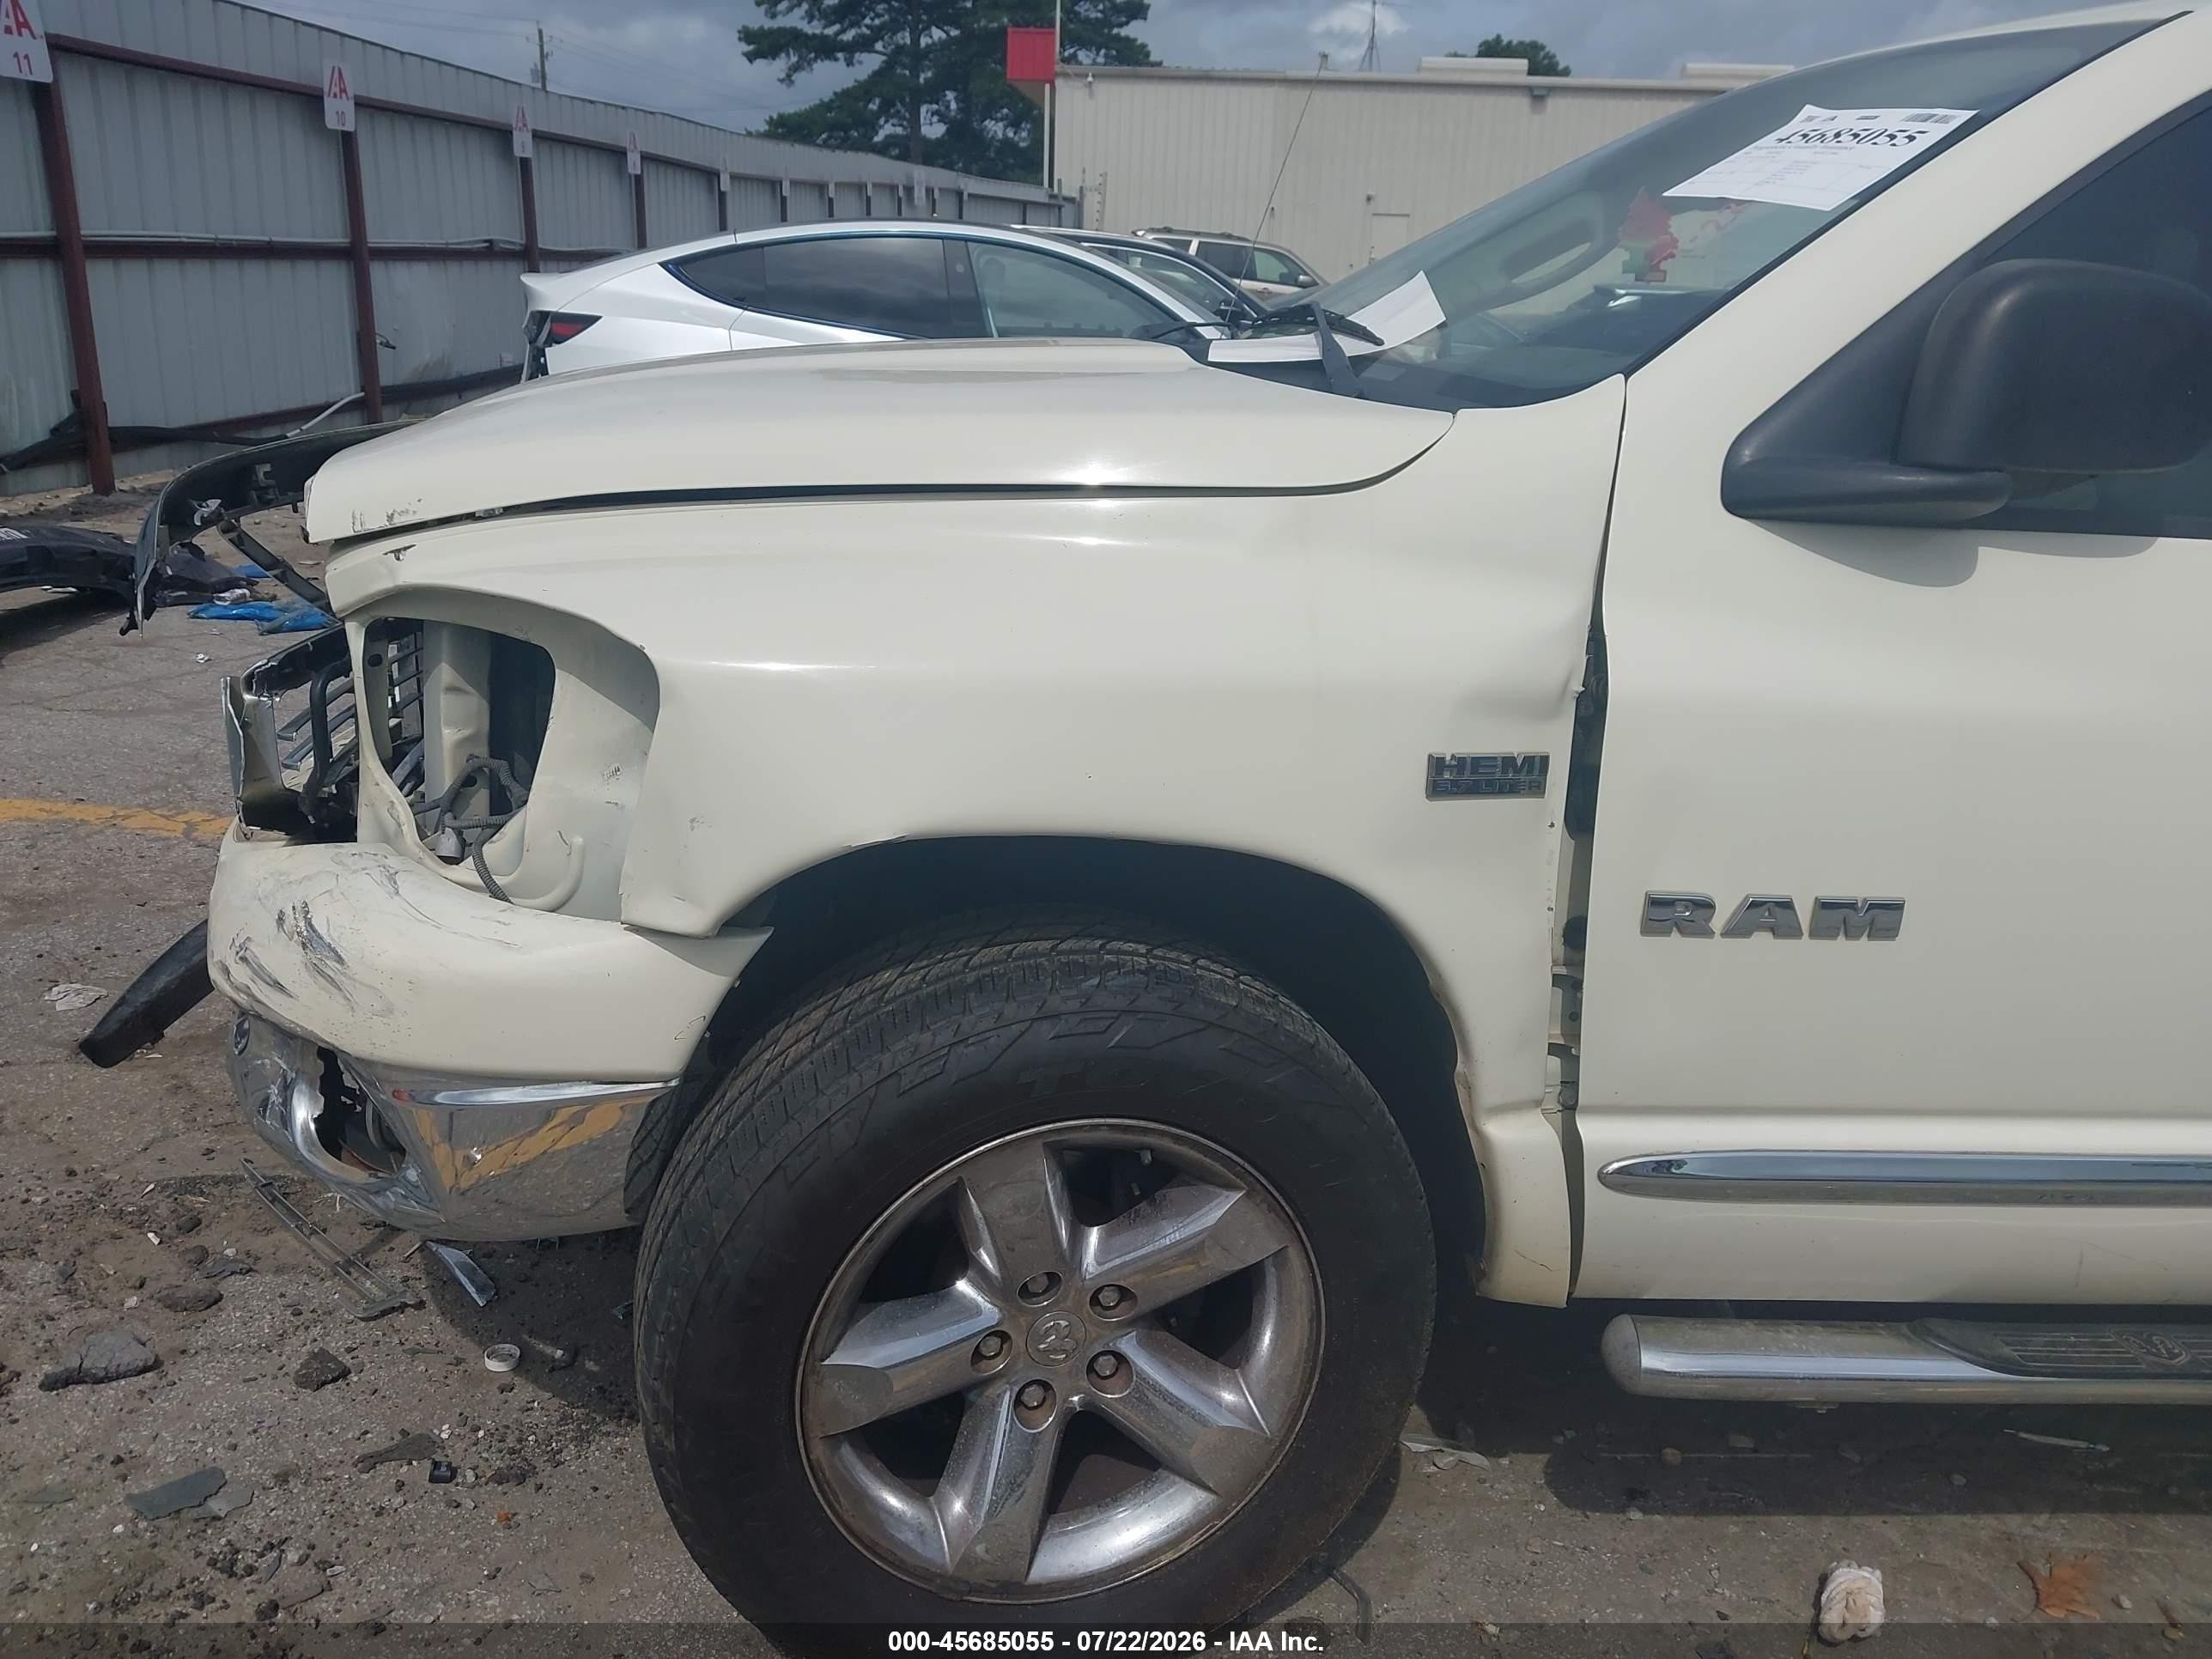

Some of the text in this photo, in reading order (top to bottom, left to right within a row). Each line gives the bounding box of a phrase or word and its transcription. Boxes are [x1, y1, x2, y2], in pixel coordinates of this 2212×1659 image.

[13, 51, 33, 76] 11
[336, 110, 347, 127] 10
[1775, 127, 1929, 147] 45685055
[1428, 754, 1550, 778] HEMI
[1481, 779, 1541, 793] LITER
[1640, 890, 1906, 942] RAM
